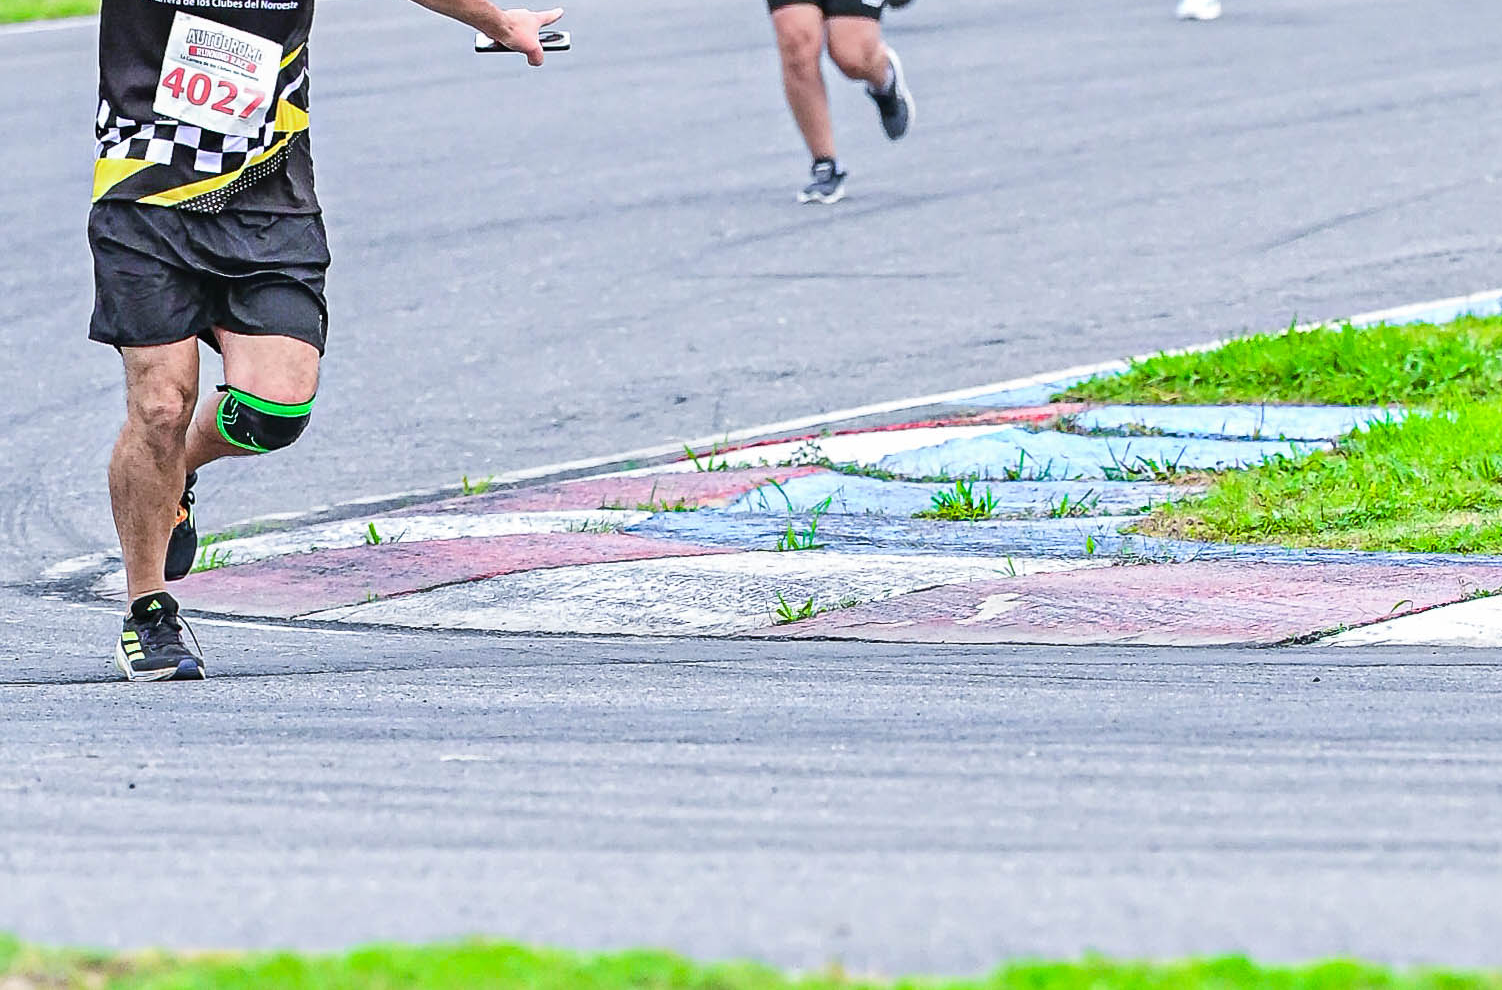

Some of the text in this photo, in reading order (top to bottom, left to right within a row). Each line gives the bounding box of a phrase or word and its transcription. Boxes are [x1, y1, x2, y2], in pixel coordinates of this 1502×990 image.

[244, 0, 260, 9] del
[260, 0, 299, 10] Noroeste
[162, 66, 266, 120] 4027
